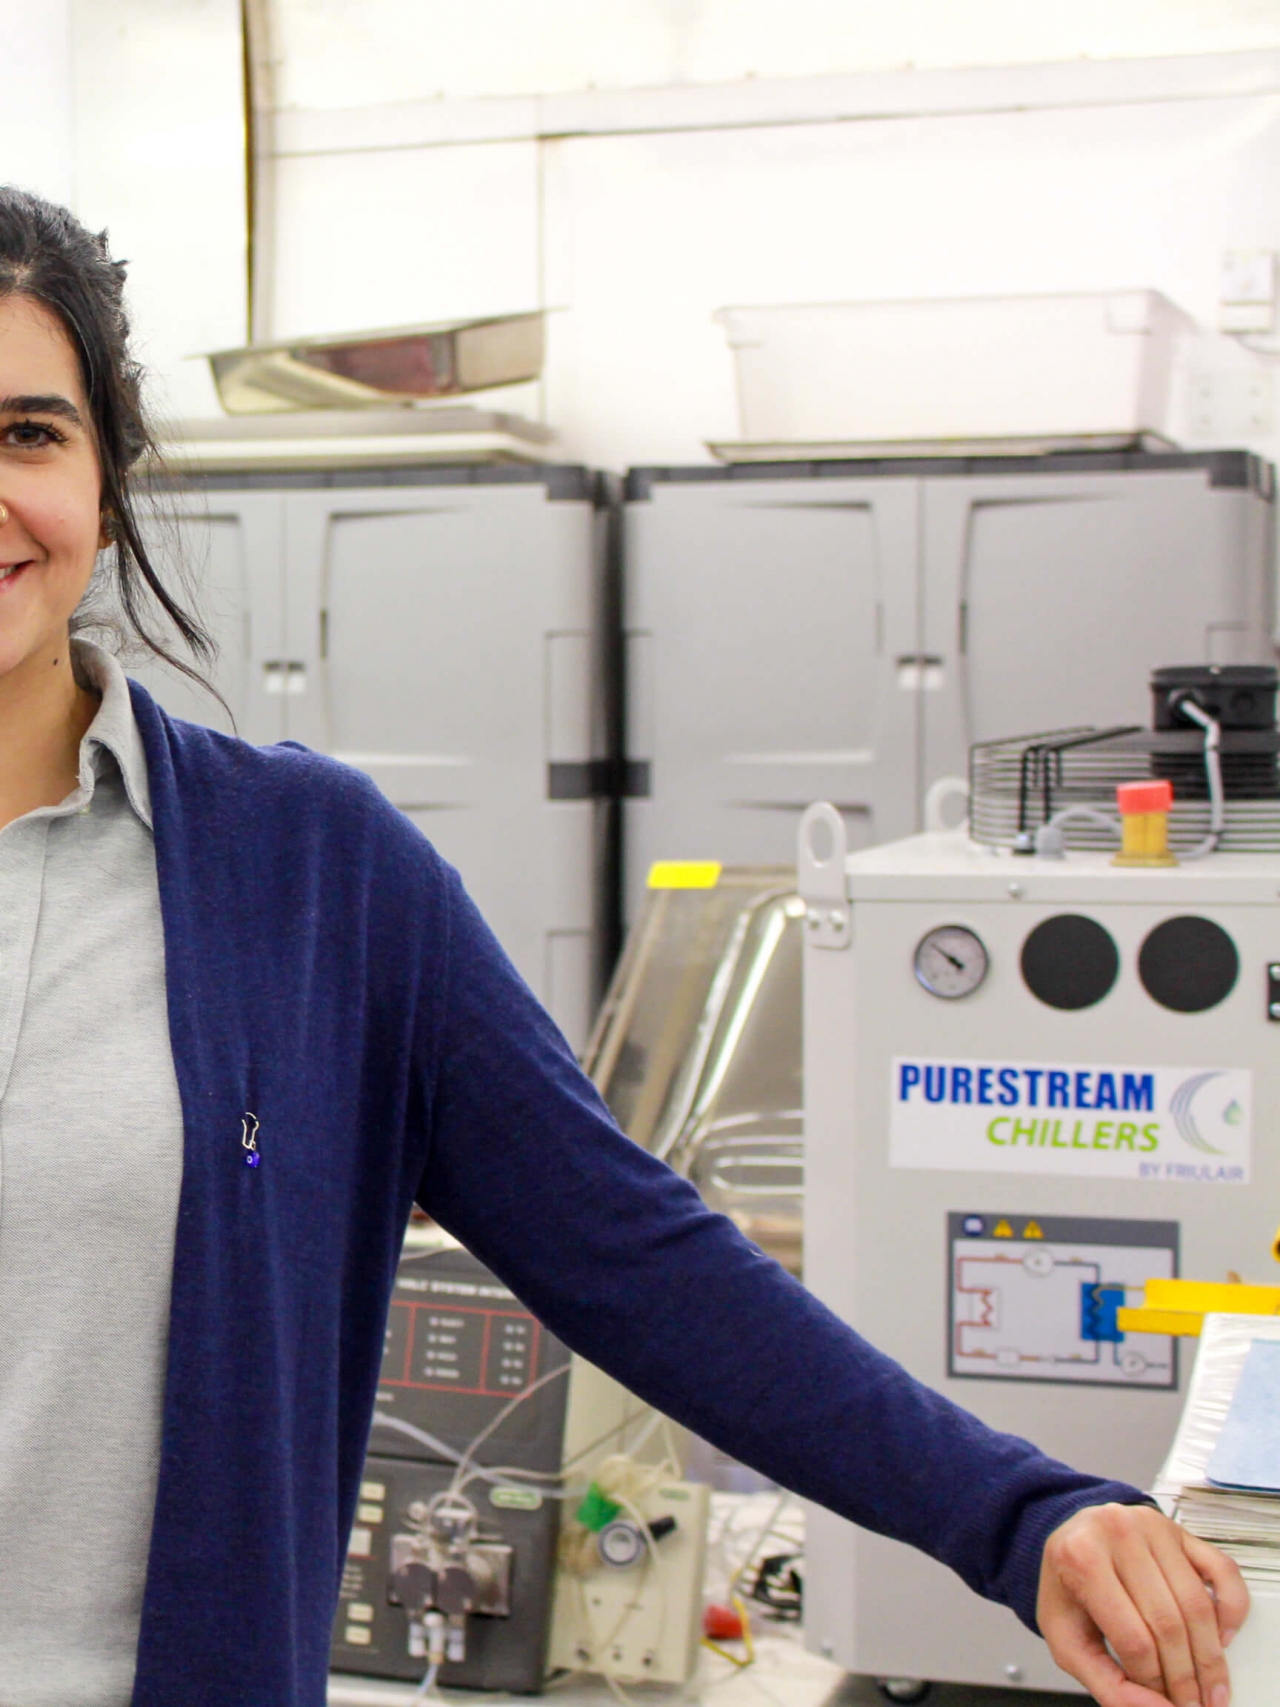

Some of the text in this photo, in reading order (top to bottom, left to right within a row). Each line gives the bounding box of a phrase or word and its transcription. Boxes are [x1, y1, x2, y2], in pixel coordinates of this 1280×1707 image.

[899, 1064, 1154, 1112] PURESTREAM
[986, 1116, 1160, 1153] CHILLERS
[1139, 1162, 1161, 1177] BY
